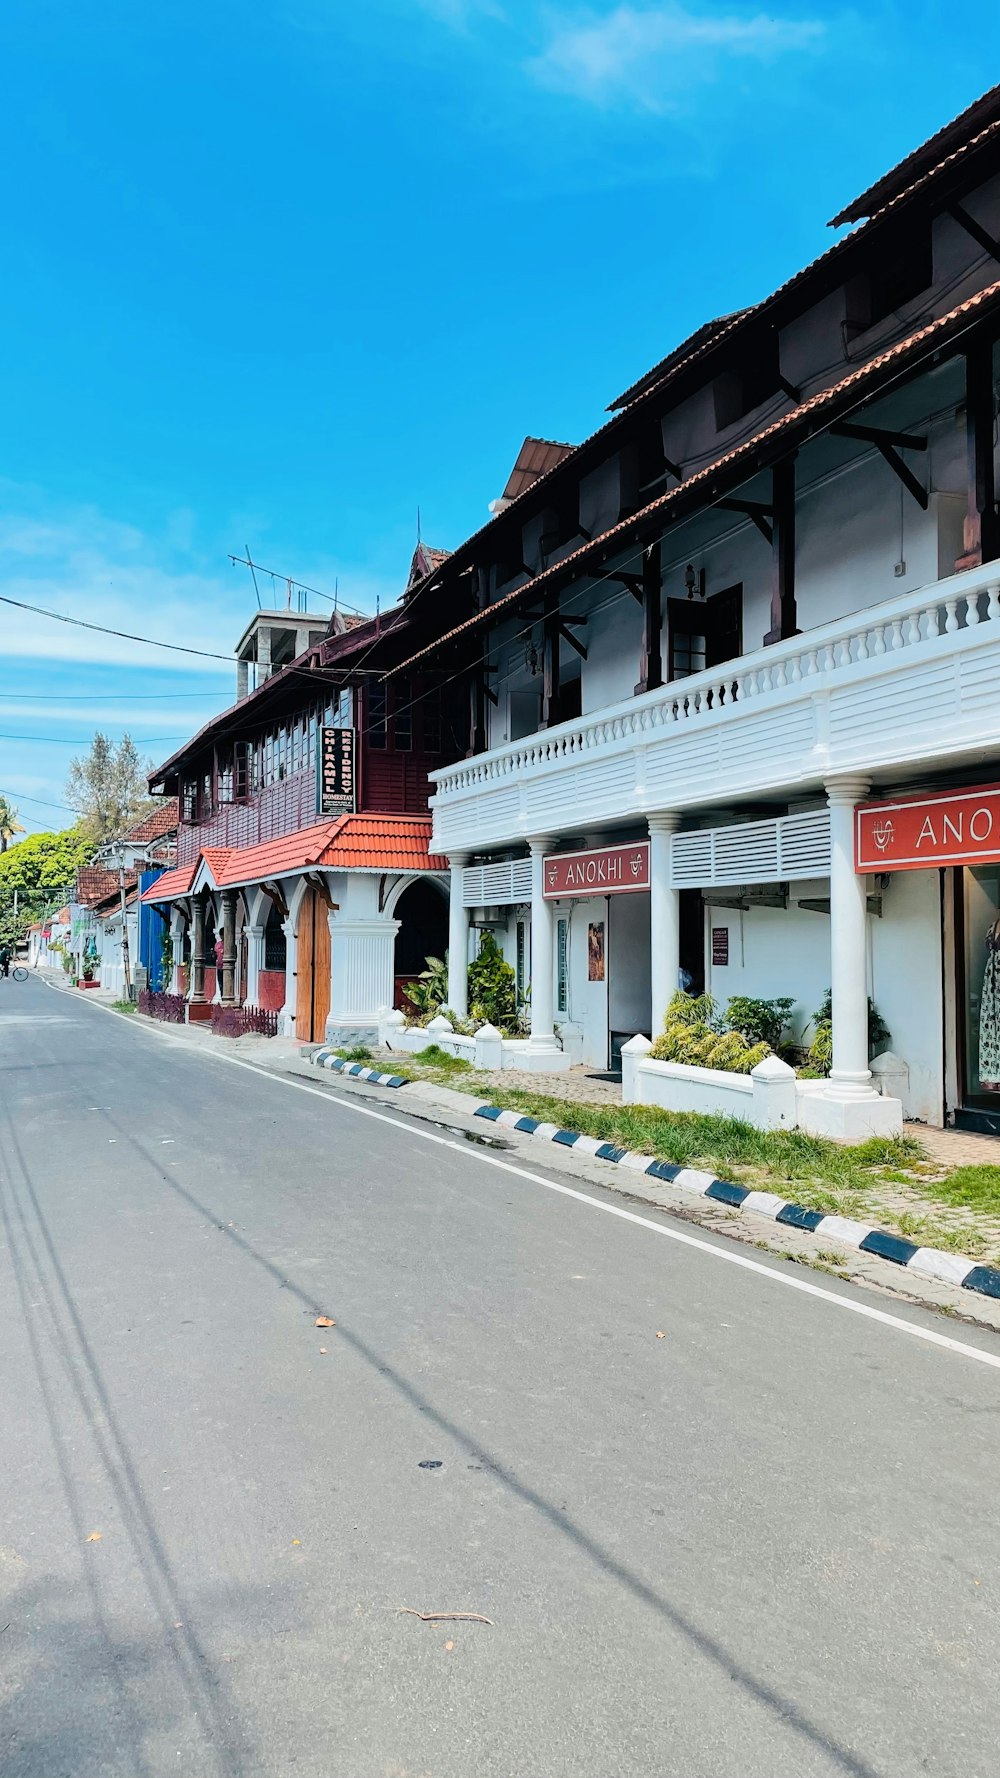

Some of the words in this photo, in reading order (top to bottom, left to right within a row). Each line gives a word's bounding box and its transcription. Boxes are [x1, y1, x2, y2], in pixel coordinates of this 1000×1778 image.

[324, 729, 336, 793] CHIRAMEL
[341, 731, 352, 793] RESIDENCY
[322, 793, 353, 801] HOMESTAY
[565, 857, 622, 885] ANOKHI
